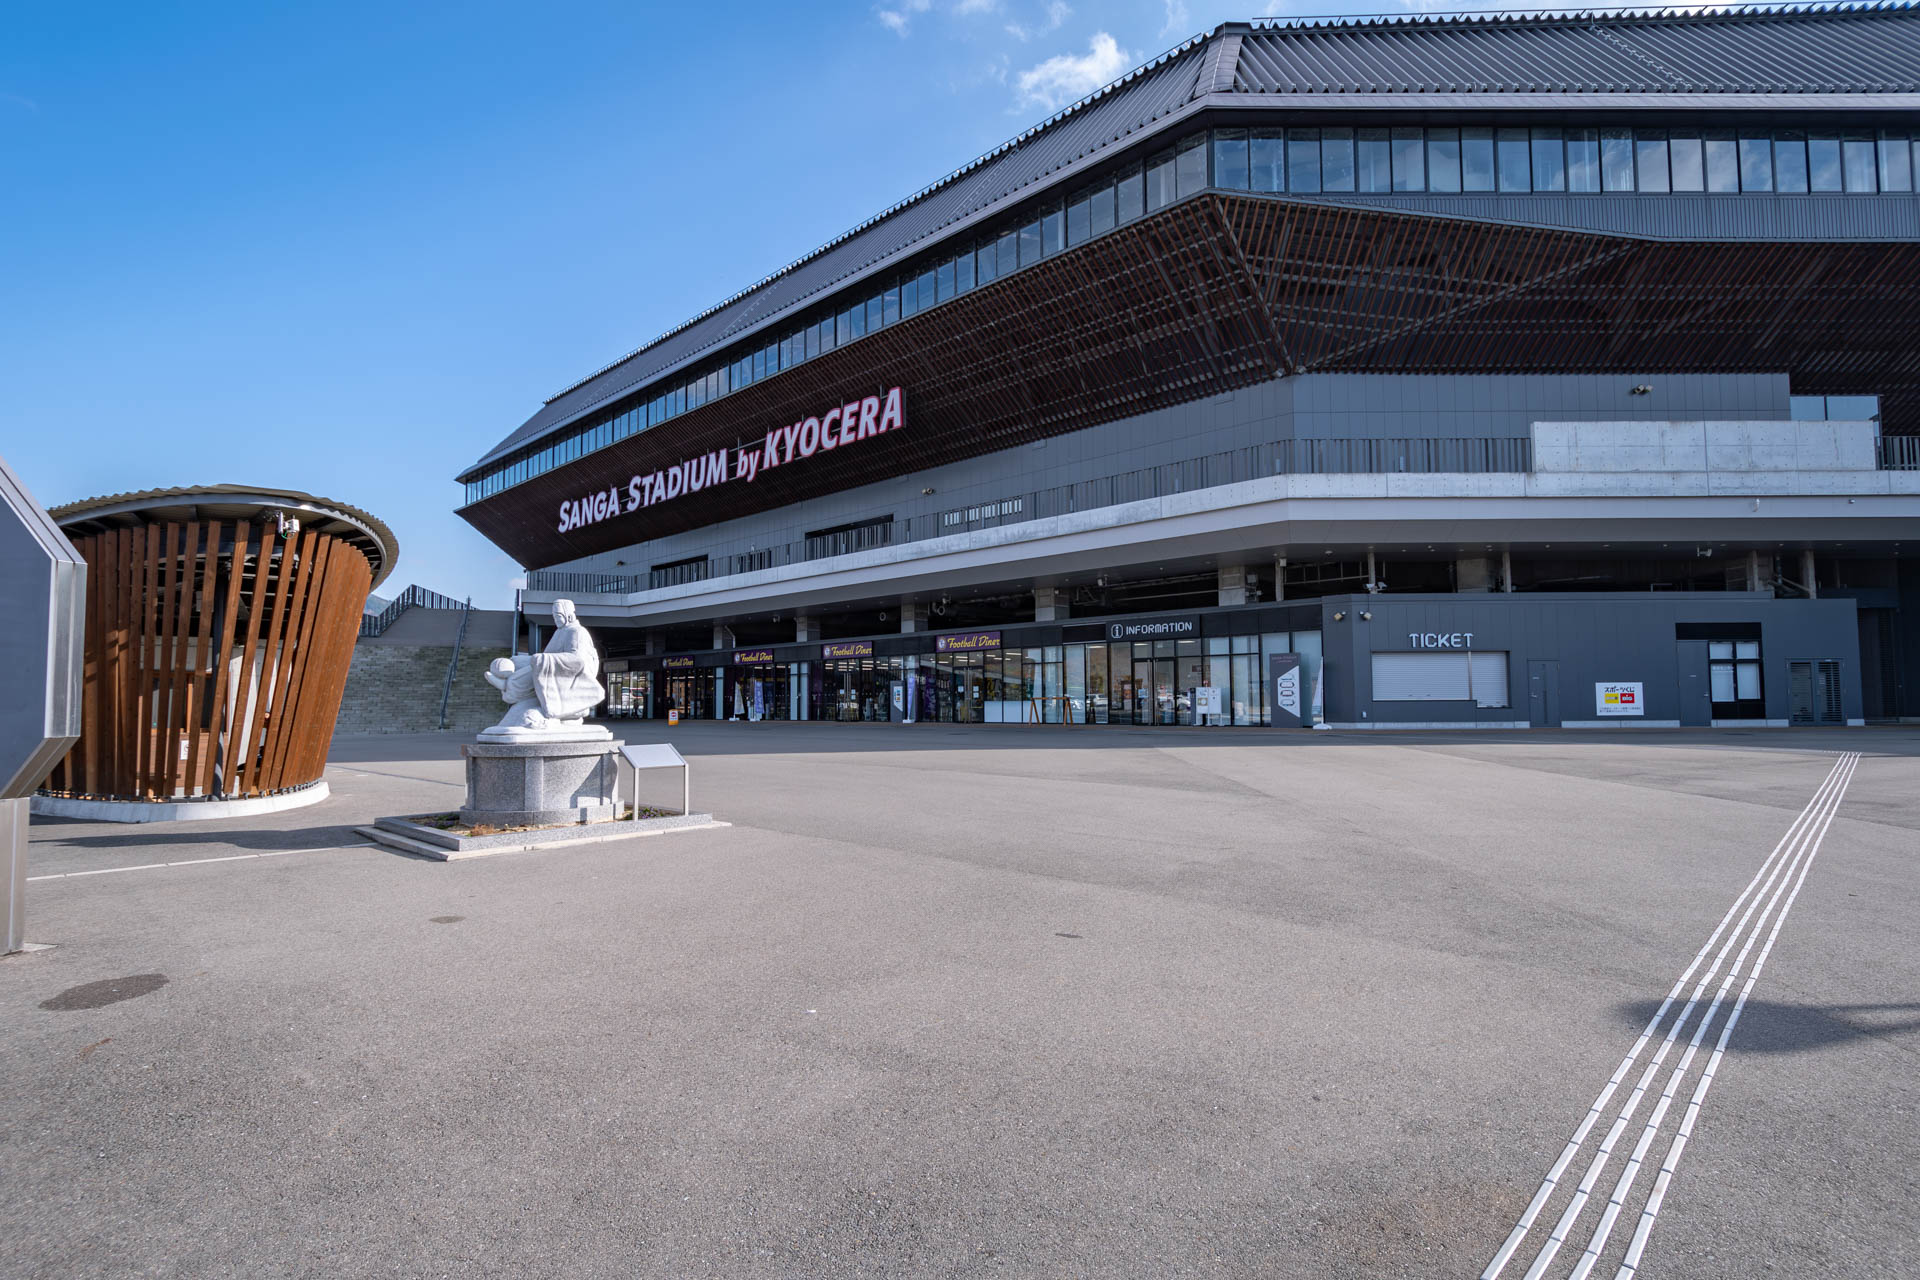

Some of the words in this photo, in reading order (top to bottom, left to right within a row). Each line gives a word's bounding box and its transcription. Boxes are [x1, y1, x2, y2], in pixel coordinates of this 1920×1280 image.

[558, 487, 621, 533] SANGA
[627, 448, 729, 512] STADIUM
[736, 449, 761, 482] by
[763, 386, 903, 470] KYOCERA
[1126, 621, 1193, 635] INFORMATION
[947, 636, 977, 649] Football
[978, 635, 1000, 647] Diner
[1409, 633, 1473, 648] TICKET
[831, 644, 855, 656] Football
